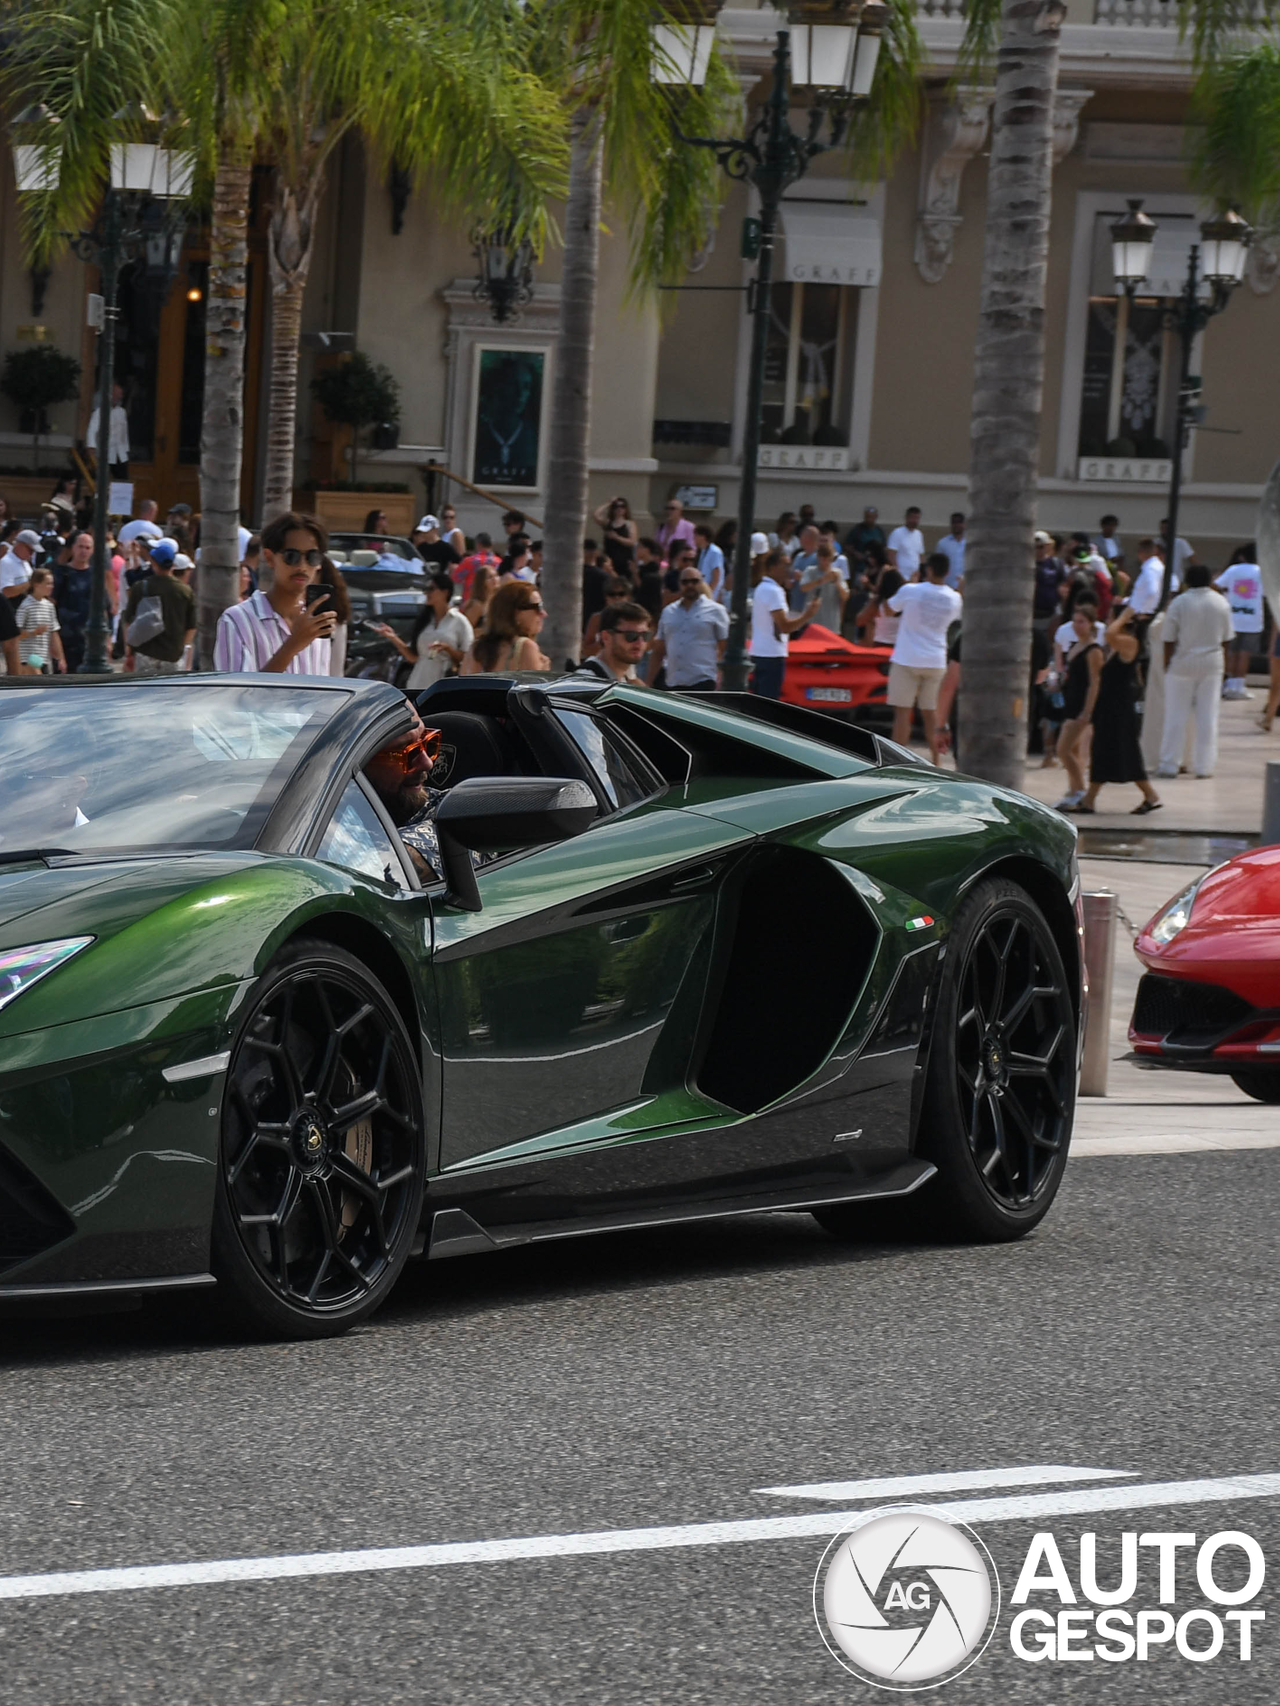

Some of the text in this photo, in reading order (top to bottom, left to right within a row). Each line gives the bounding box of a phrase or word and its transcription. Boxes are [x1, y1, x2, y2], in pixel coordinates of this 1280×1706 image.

[793, 264, 877, 281] GRAFF
[761, 450, 841, 467] GRAFF
[1087, 462, 1168, 479] GRAFF
